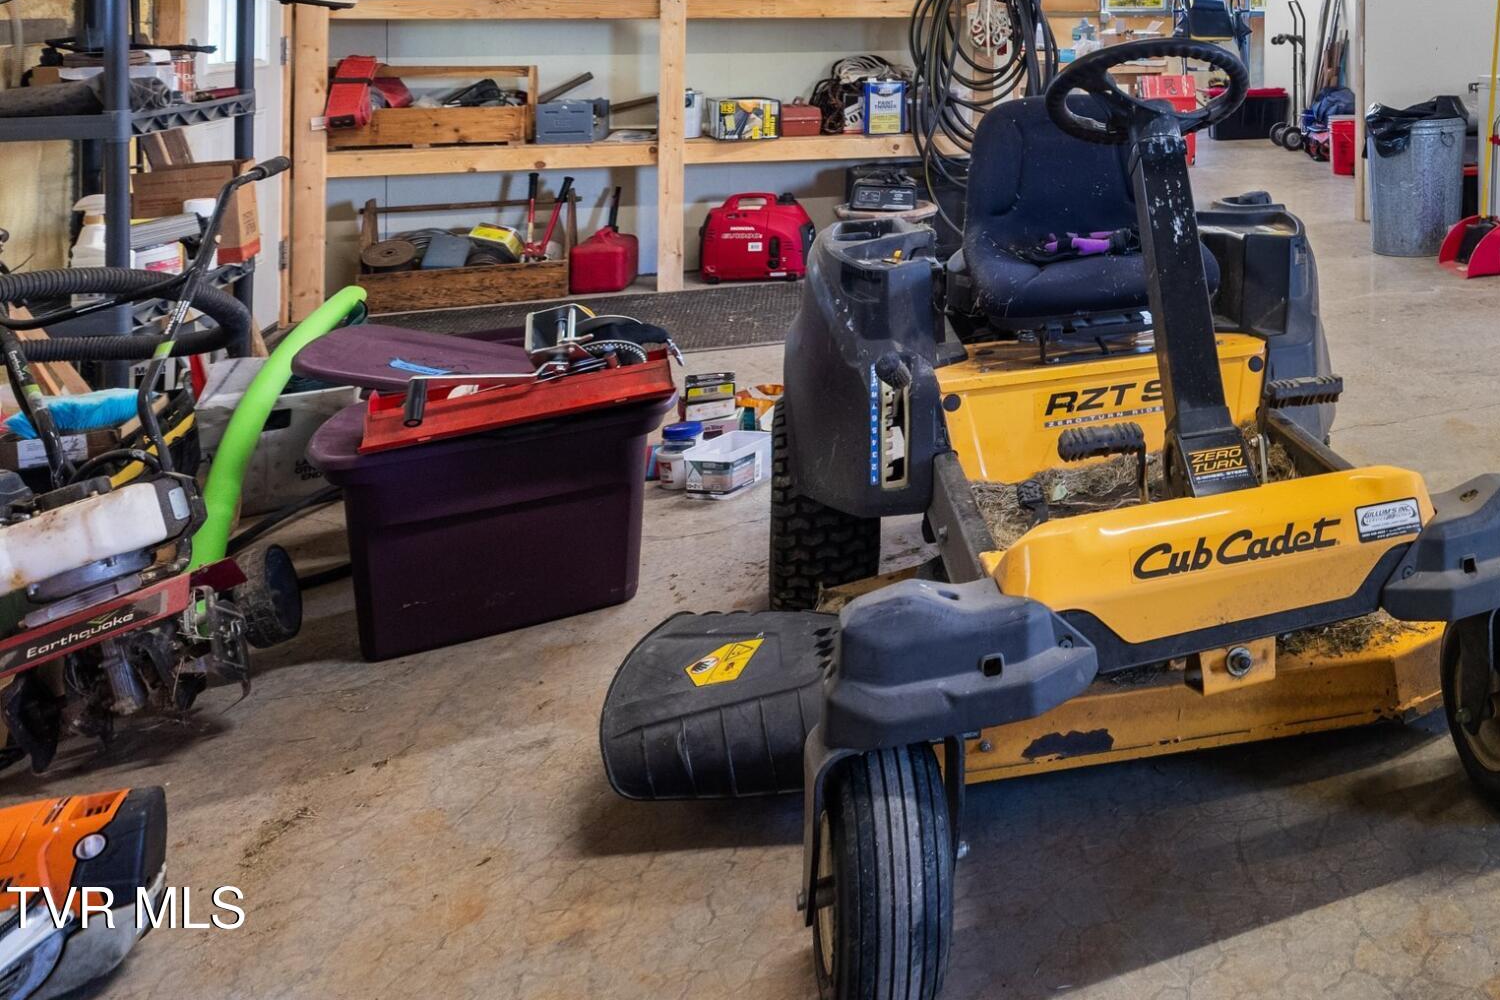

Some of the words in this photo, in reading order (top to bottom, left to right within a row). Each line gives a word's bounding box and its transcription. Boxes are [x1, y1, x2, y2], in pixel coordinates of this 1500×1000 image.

[1045, 383, 1136, 416] RZT
[1132, 406, 1162, 415] RIDE
[1191, 448, 1242, 464] ZERO
[1193, 457, 1243, 473] TURN
[1133, 537, 1213, 580] Cub
[1216, 517, 1341, 565] Cadet
[26, 612, 134, 660] Earthquake
